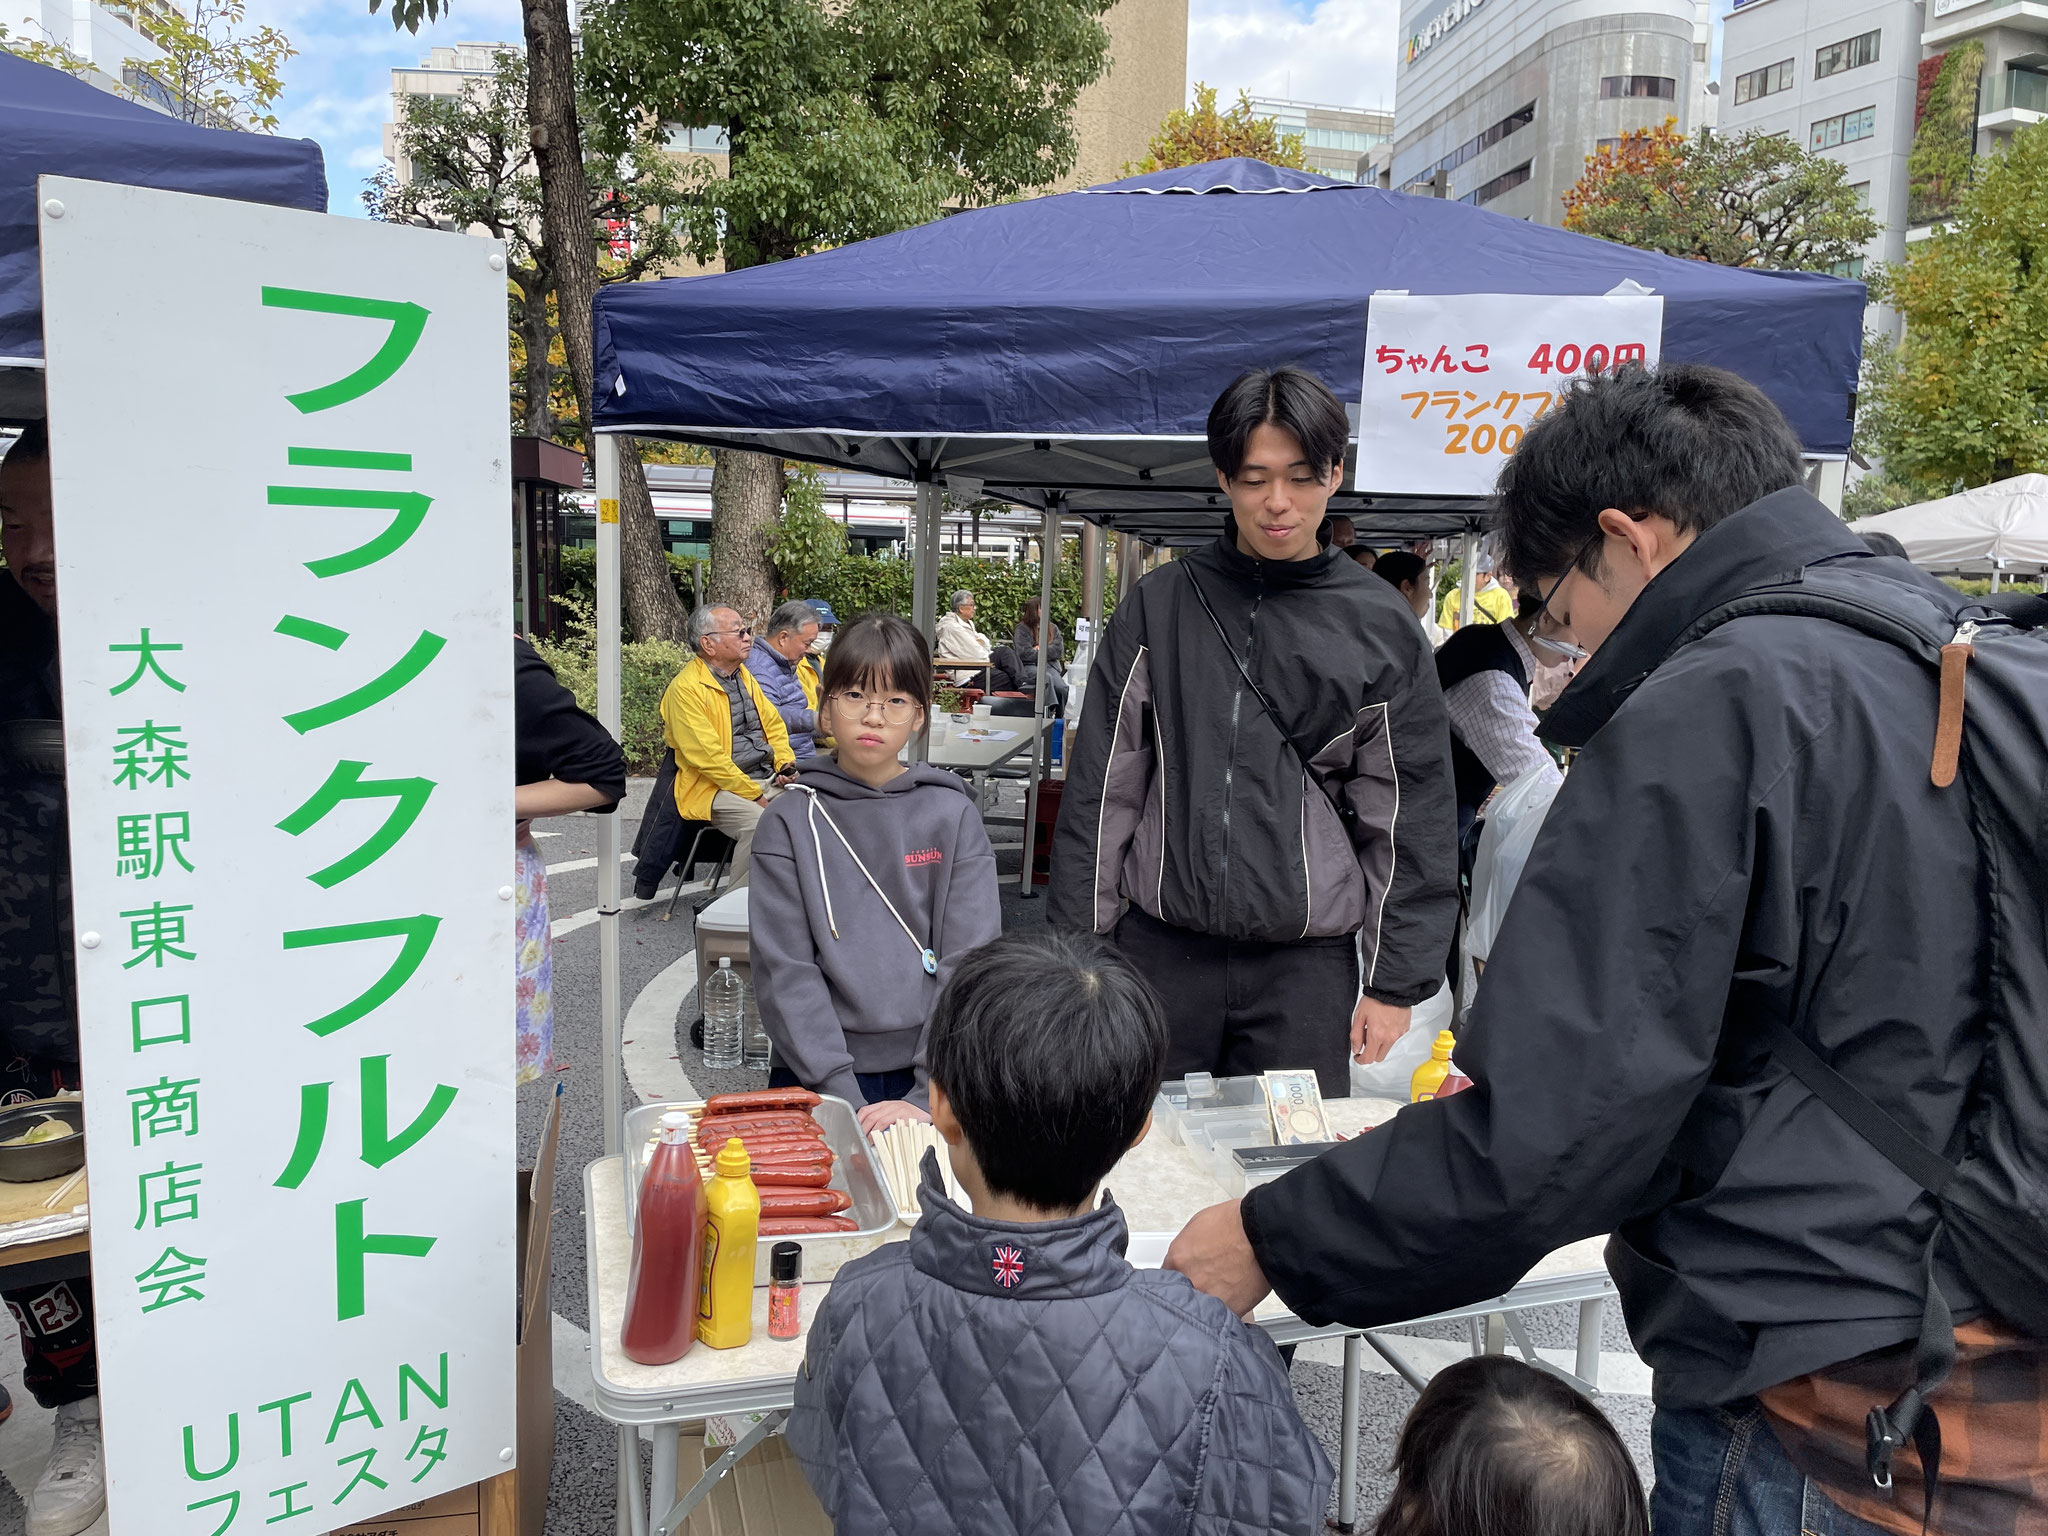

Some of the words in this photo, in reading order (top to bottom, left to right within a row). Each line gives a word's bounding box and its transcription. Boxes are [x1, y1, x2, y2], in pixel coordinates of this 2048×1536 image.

[1376, 344, 1490, 374] ちゃんこ
[1528, 343, 1646, 375] 400円
[1401, 390, 1564, 420] フランクフ
[1444, 423, 1524, 455] 200
[262, 287, 458, 1320] フランクフルト
[108, 628, 206, 1313] 大森駅東口商店会
[1289, 1083, 1305, 1105] 1000
[34, 1287, 79, 1332] 23
[184, 1354, 449, 1482] UTAN
[187, 1425, 448, 1536] フェスタ
